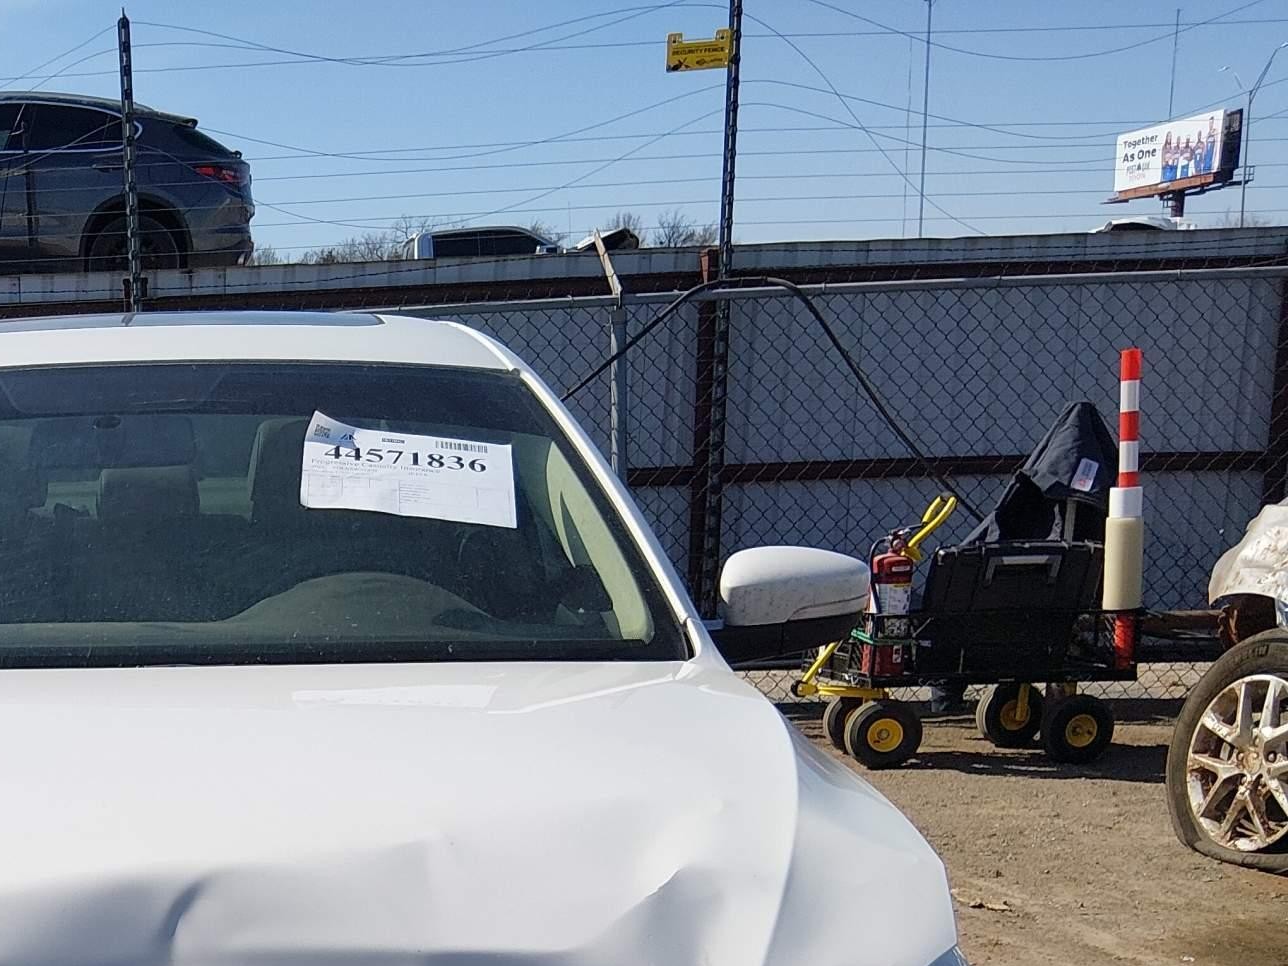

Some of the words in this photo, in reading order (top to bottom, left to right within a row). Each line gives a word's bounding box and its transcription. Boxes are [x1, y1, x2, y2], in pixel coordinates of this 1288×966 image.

[1123, 135, 1158, 149] Together
[1122, 153, 1135, 163] As
[1137, 148, 1157, 160] One
[324, 445, 487, 473] 44571836
